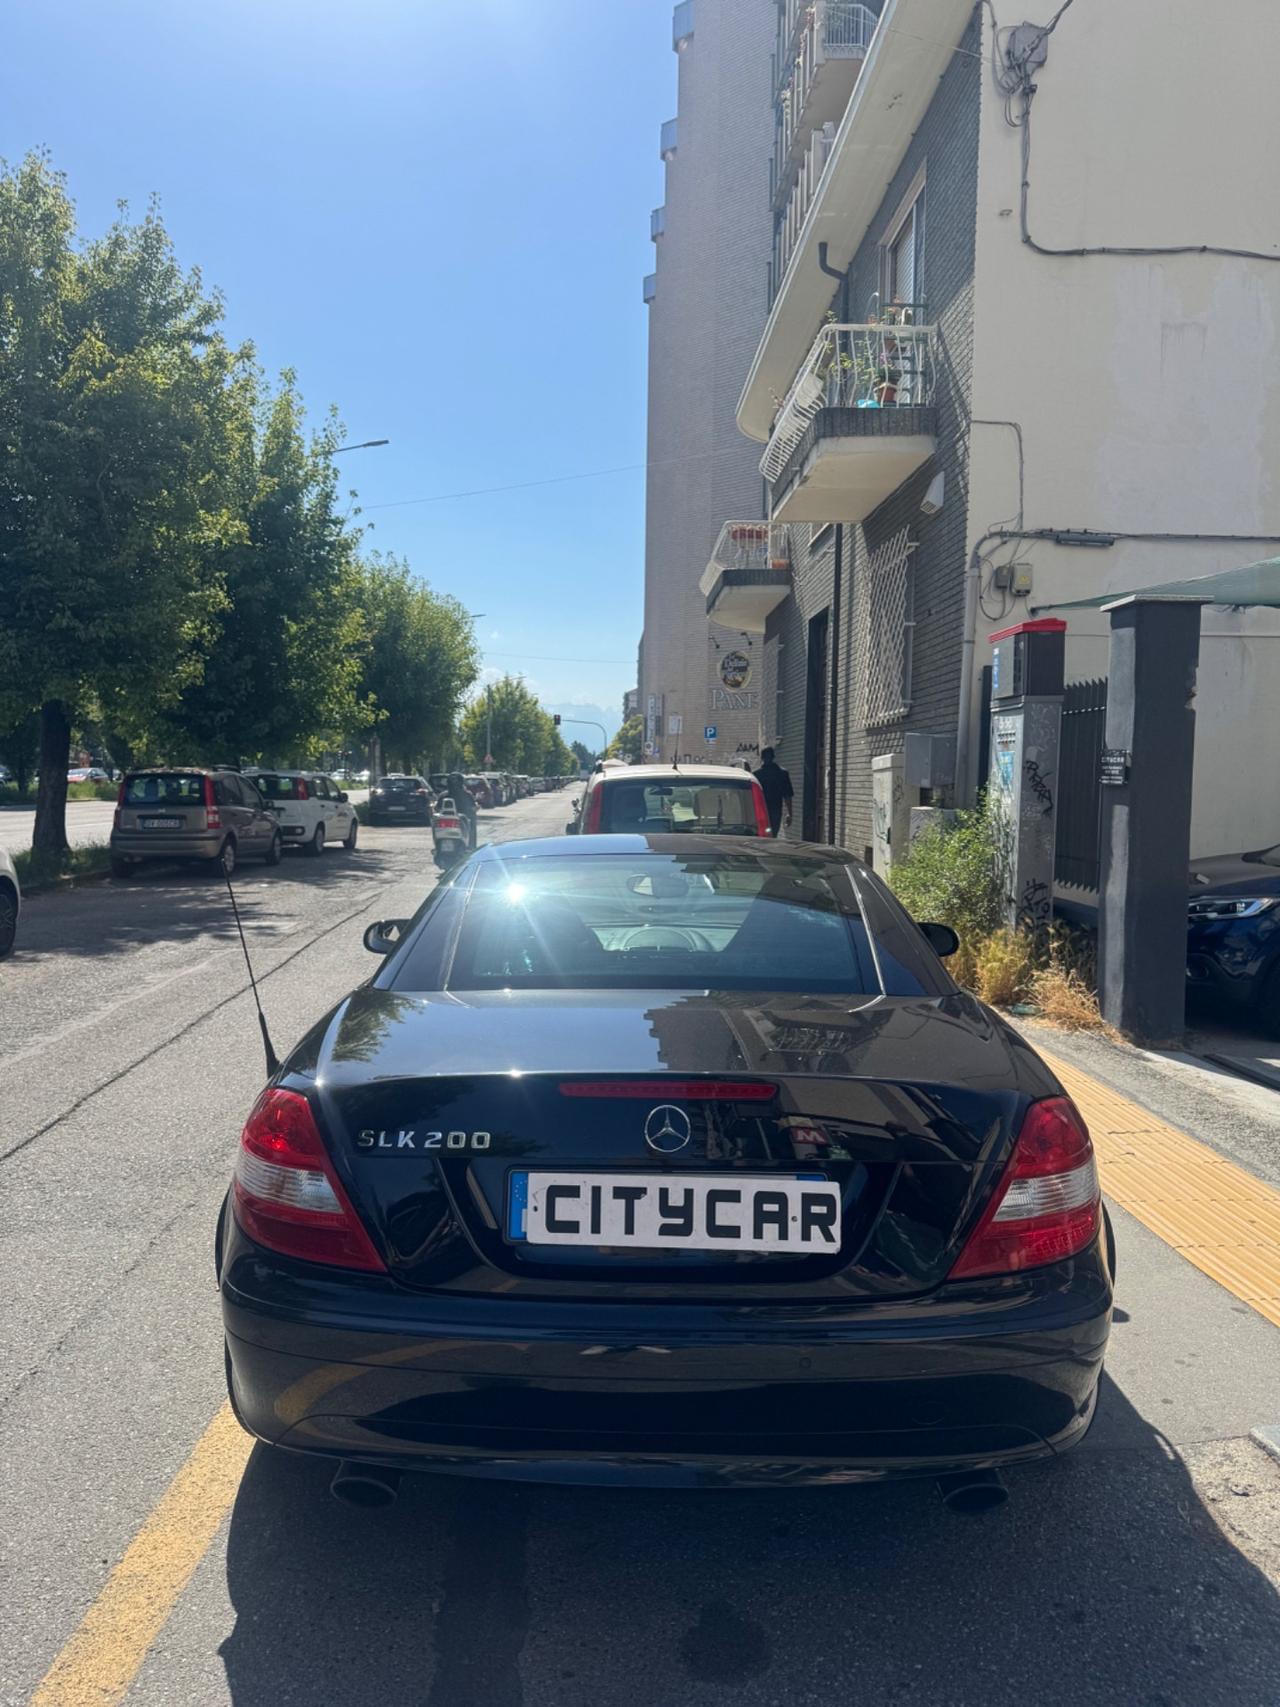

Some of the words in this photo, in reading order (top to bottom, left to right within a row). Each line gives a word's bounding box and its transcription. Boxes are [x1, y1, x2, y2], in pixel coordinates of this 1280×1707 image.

[706, 727, 715, 737] P
[358, 1129, 416, 1148] SLK
[424, 1131, 491, 1149] 200
[545, 1184, 837, 1243] CITYCAR
